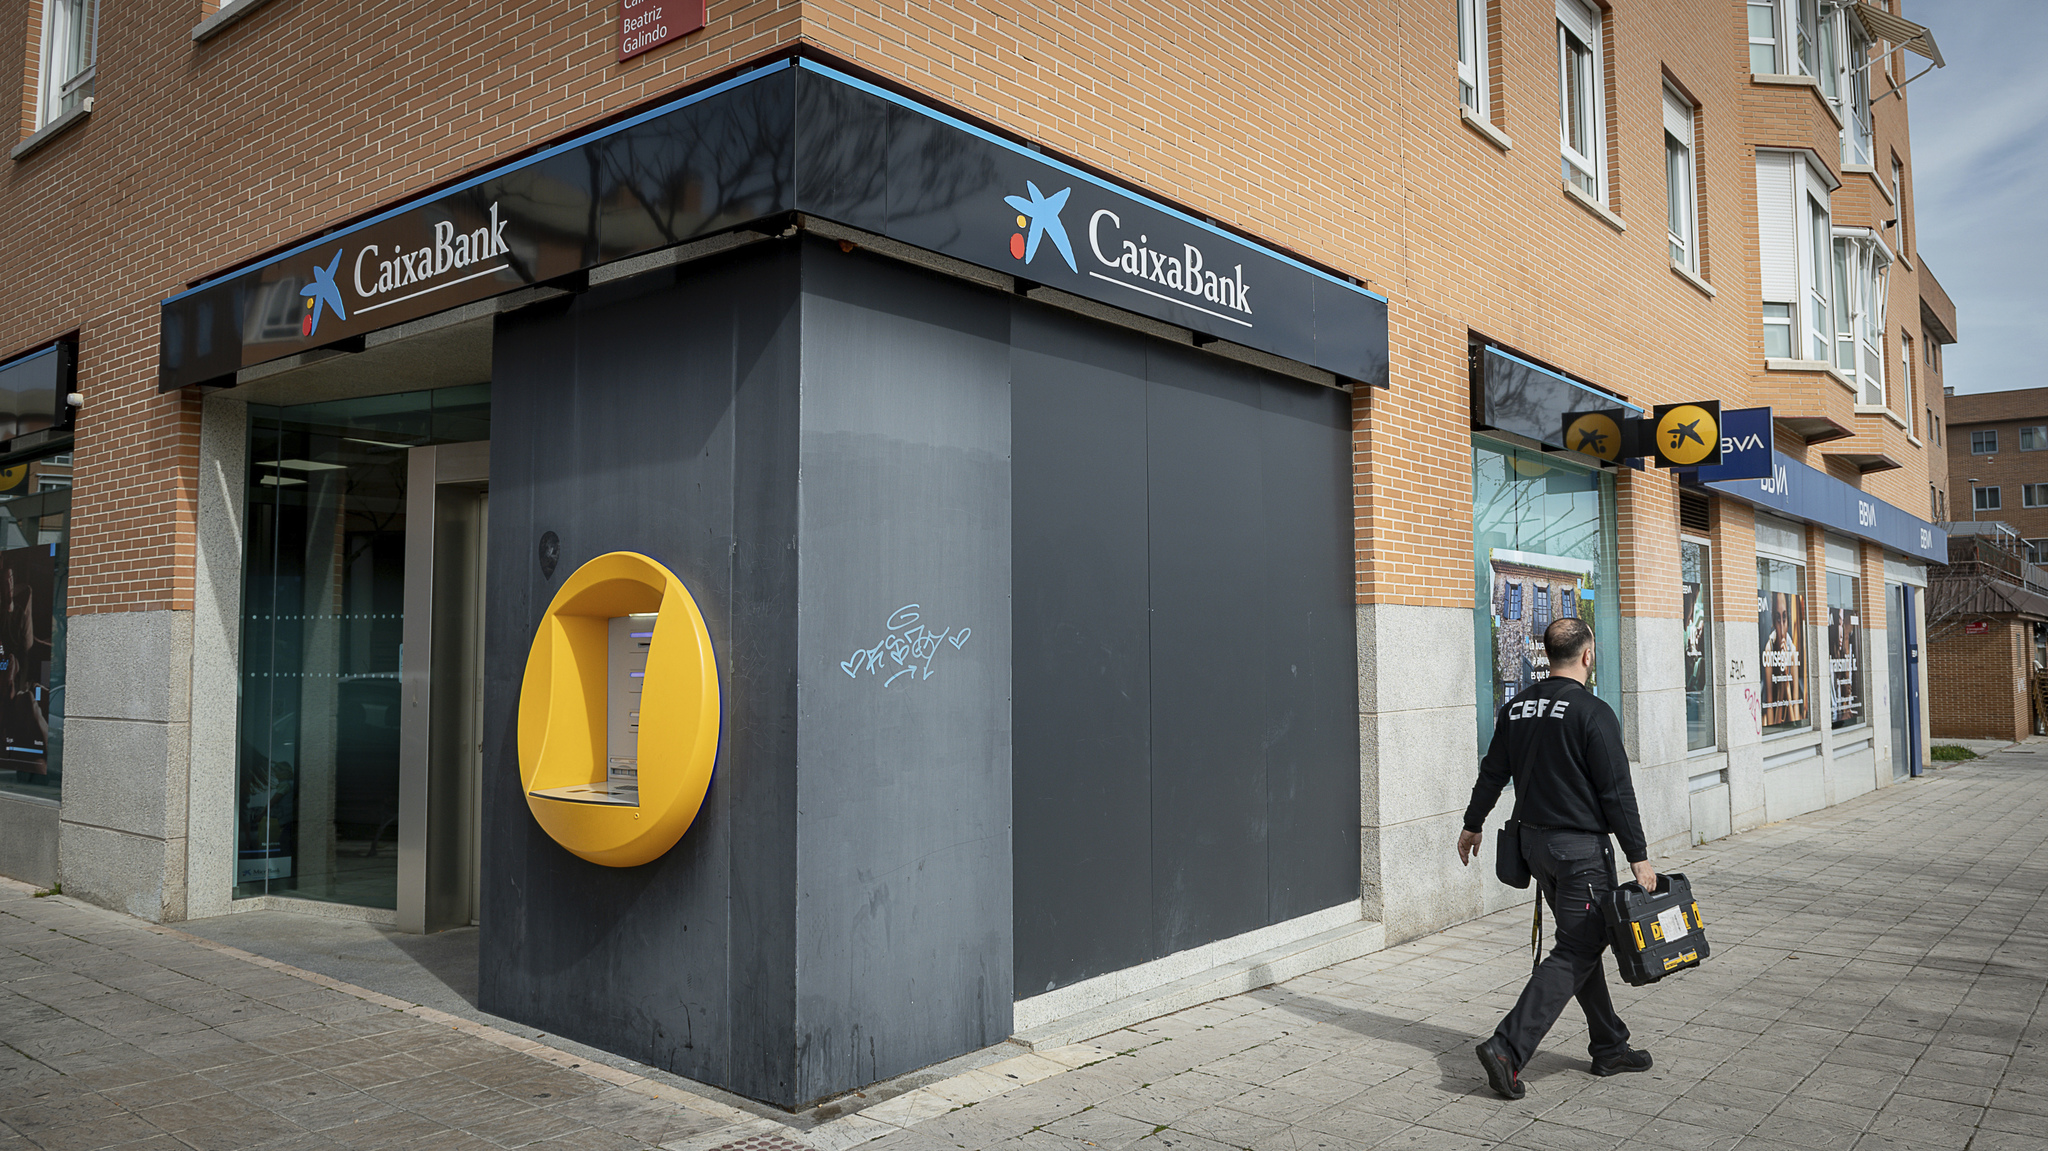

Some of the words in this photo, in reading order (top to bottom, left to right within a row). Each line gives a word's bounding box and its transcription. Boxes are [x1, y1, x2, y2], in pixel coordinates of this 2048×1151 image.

[623, 5, 662, 34] Beatriz
[623, 23, 668, 53] Galindo
[354, 201, 509, 297] CaixaBank
[1088, 209, 1252, 314] CaixaBank
[1721, 433, 1765, 453] BVA
[1858, 500, 1877, 527] BBVA
[1920, 527, 1933, 549] BBVA
